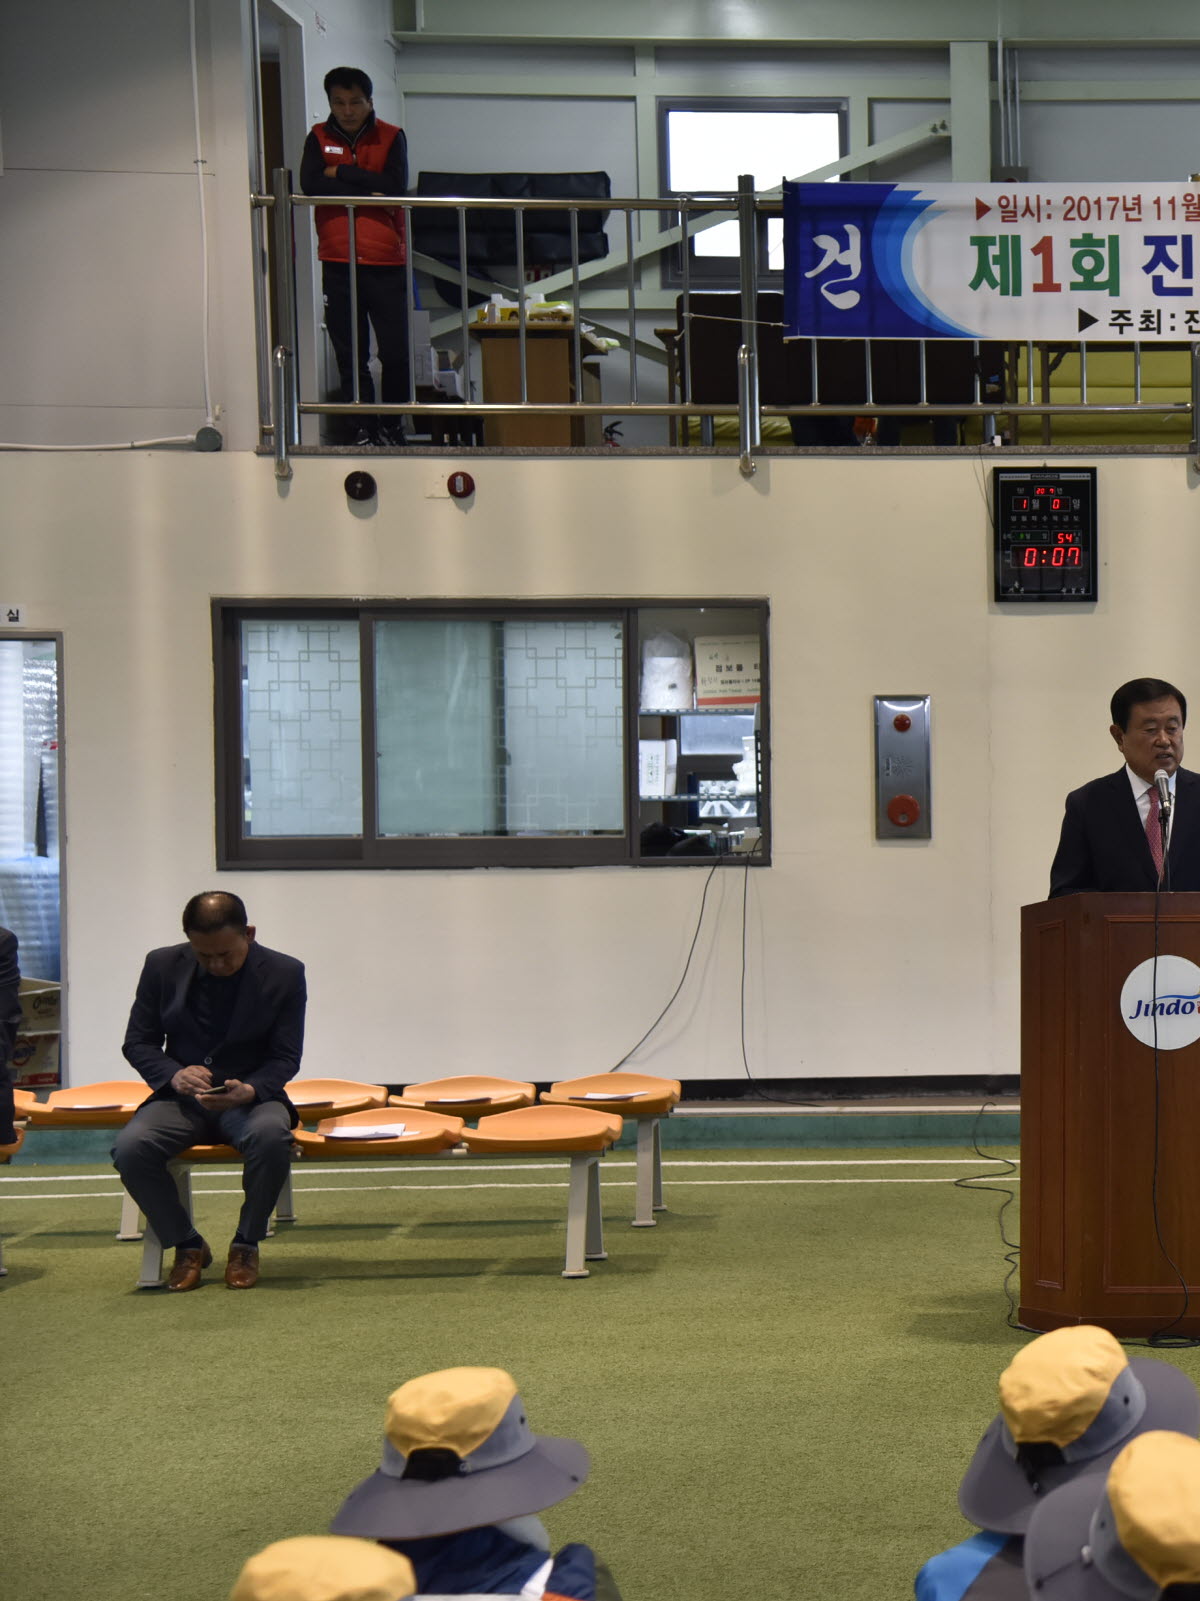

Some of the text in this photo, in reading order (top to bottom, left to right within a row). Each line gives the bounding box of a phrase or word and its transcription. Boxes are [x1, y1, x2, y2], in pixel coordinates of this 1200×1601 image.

[997, 194, 1052, 224] 일시:
[1062, 194, 1143, 223] 2017년
[804, 223, 862, 310] 건
[968, 232, 1120, 297] 제1회
[1057, 533, 1074, 544] 54
[1129, 999, 1195, 1020] Jindo
